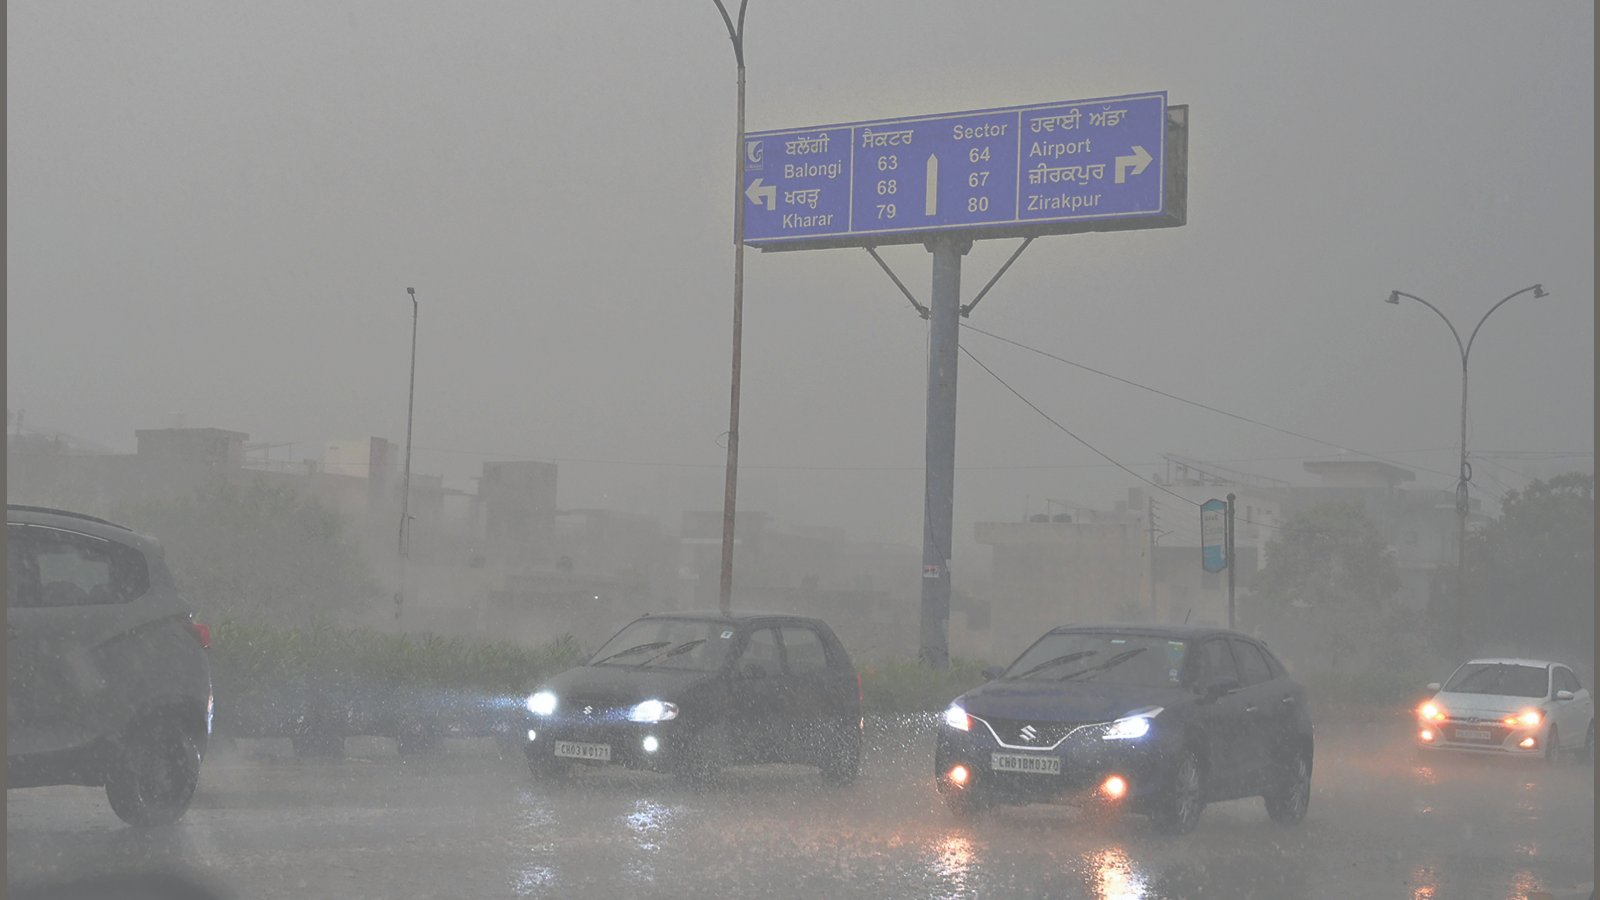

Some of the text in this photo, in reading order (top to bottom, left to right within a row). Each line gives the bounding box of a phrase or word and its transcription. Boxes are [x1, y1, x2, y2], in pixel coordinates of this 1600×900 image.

[1030, 105, 1127, 133] ਹਵਾਈ ਅੱਡਾ
[862, 128, 914, 148] ਸੈਕਟਰ
[953, 123, 1008, 140] Sector
[969, 146, 991, 163] 64
[1029, 138, 1091, 159] Airport
[784, 160, 842, 179] Balongi
[877, 155, 898, 171] 63
[877, 179, 897, 195] 68
[968, 171, 990, 187] 67
[967, 196, 989, 212] 80
[1027, 193, 1102, 212] Zirakpur
[876, 204, 897, 219] 79
[783, 213, 834, 229] Kharar
